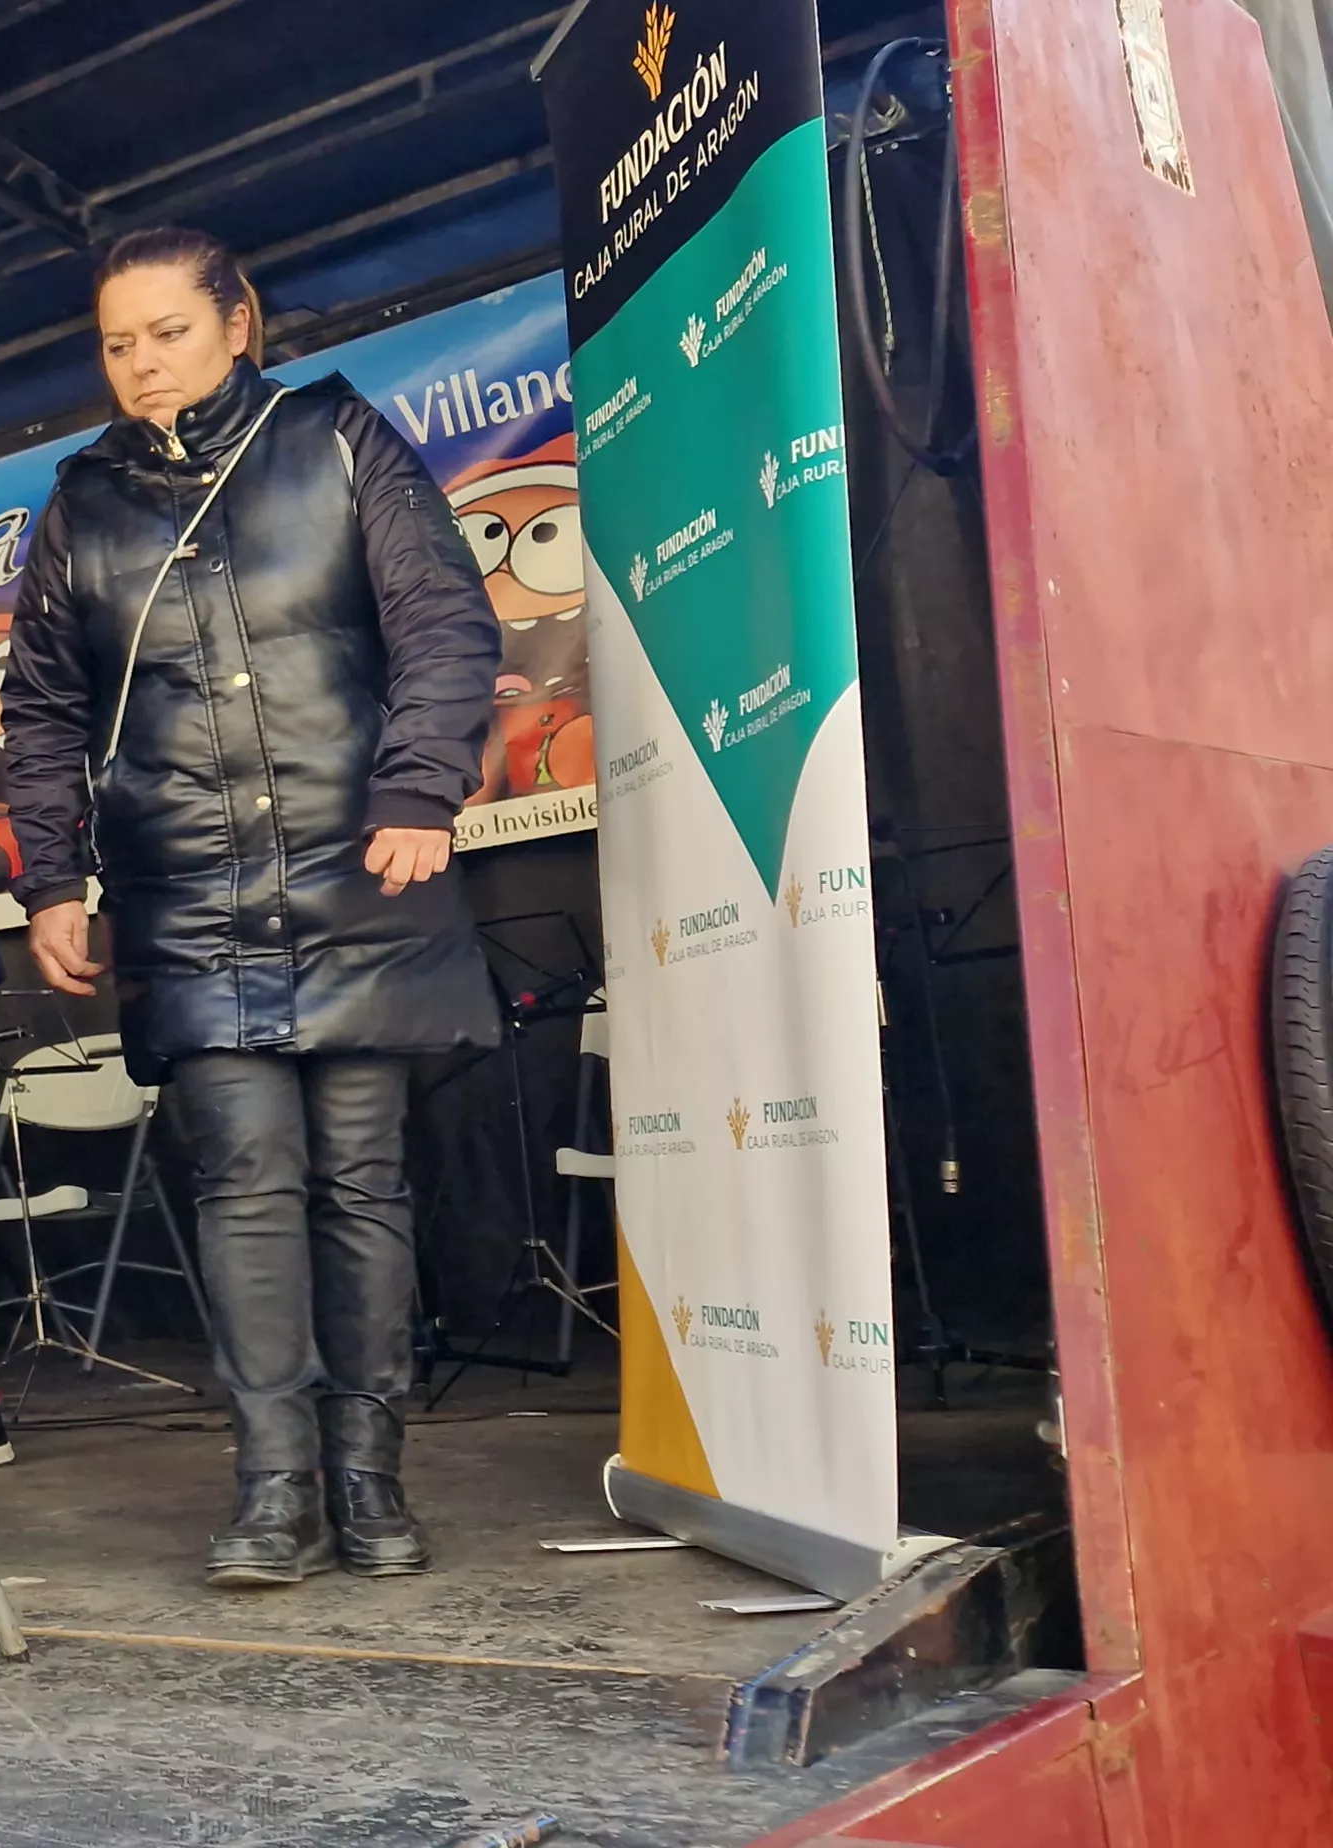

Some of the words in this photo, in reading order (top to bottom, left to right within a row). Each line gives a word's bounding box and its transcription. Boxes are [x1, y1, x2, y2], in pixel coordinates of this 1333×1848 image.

[599, 41, 727, 225] FUNDACIÓN
[573, 245, 613, 300] CAJA
[614, 190, 663, 260] RURAL
[666, 156, 691, 204] DE
[695, 70, 759, 176] ARAGÓN
[715, 246, 766, 323] FUNDACIÓN
[702, 332, 723, 358] CAJA
[723, 309, 745, 341] RURAL
[744, 296, 753, 317] DE
[753, 262, 787, 304] ARAGÓN
[585, 375, 637, 437] FUNDACIÓN
[591, 427, 616, 453] RURAL
[615, 416, 625, 434] DE
[625, 392, 652, 425] ARAGÓN
[776, 474, 801, 500] CAJA
[656, 507, 717, 565] FUNDACIÓN
[645, 574, 663, 596] CAJA
[663, 559, 687, 584] RURAL
[687, 549, 700, 568] DE
[700, 528, 734, 560] ARAGÓN
[738, 662, 791, 716] FUNDACIÓN
[609, 736, 659, 780] FUNDACIÓN
[724, 727, 746, 748] CAJA
[493, 797, 598, 835] Invisible
[679, 898, 740, 939] FUNDACIÓN
[801, 906, 827, 926] CAJA
[628, 1106, 681, 1136] FUNDACIÓN
[763, 1090, 818, 1124] FUNDACIÓN
[747, 1134, 770, 1150] CAJA
[701, 1302, 760, 1332] FUNDACIÓN
[833, 1353, 858, 1371] CAJA
